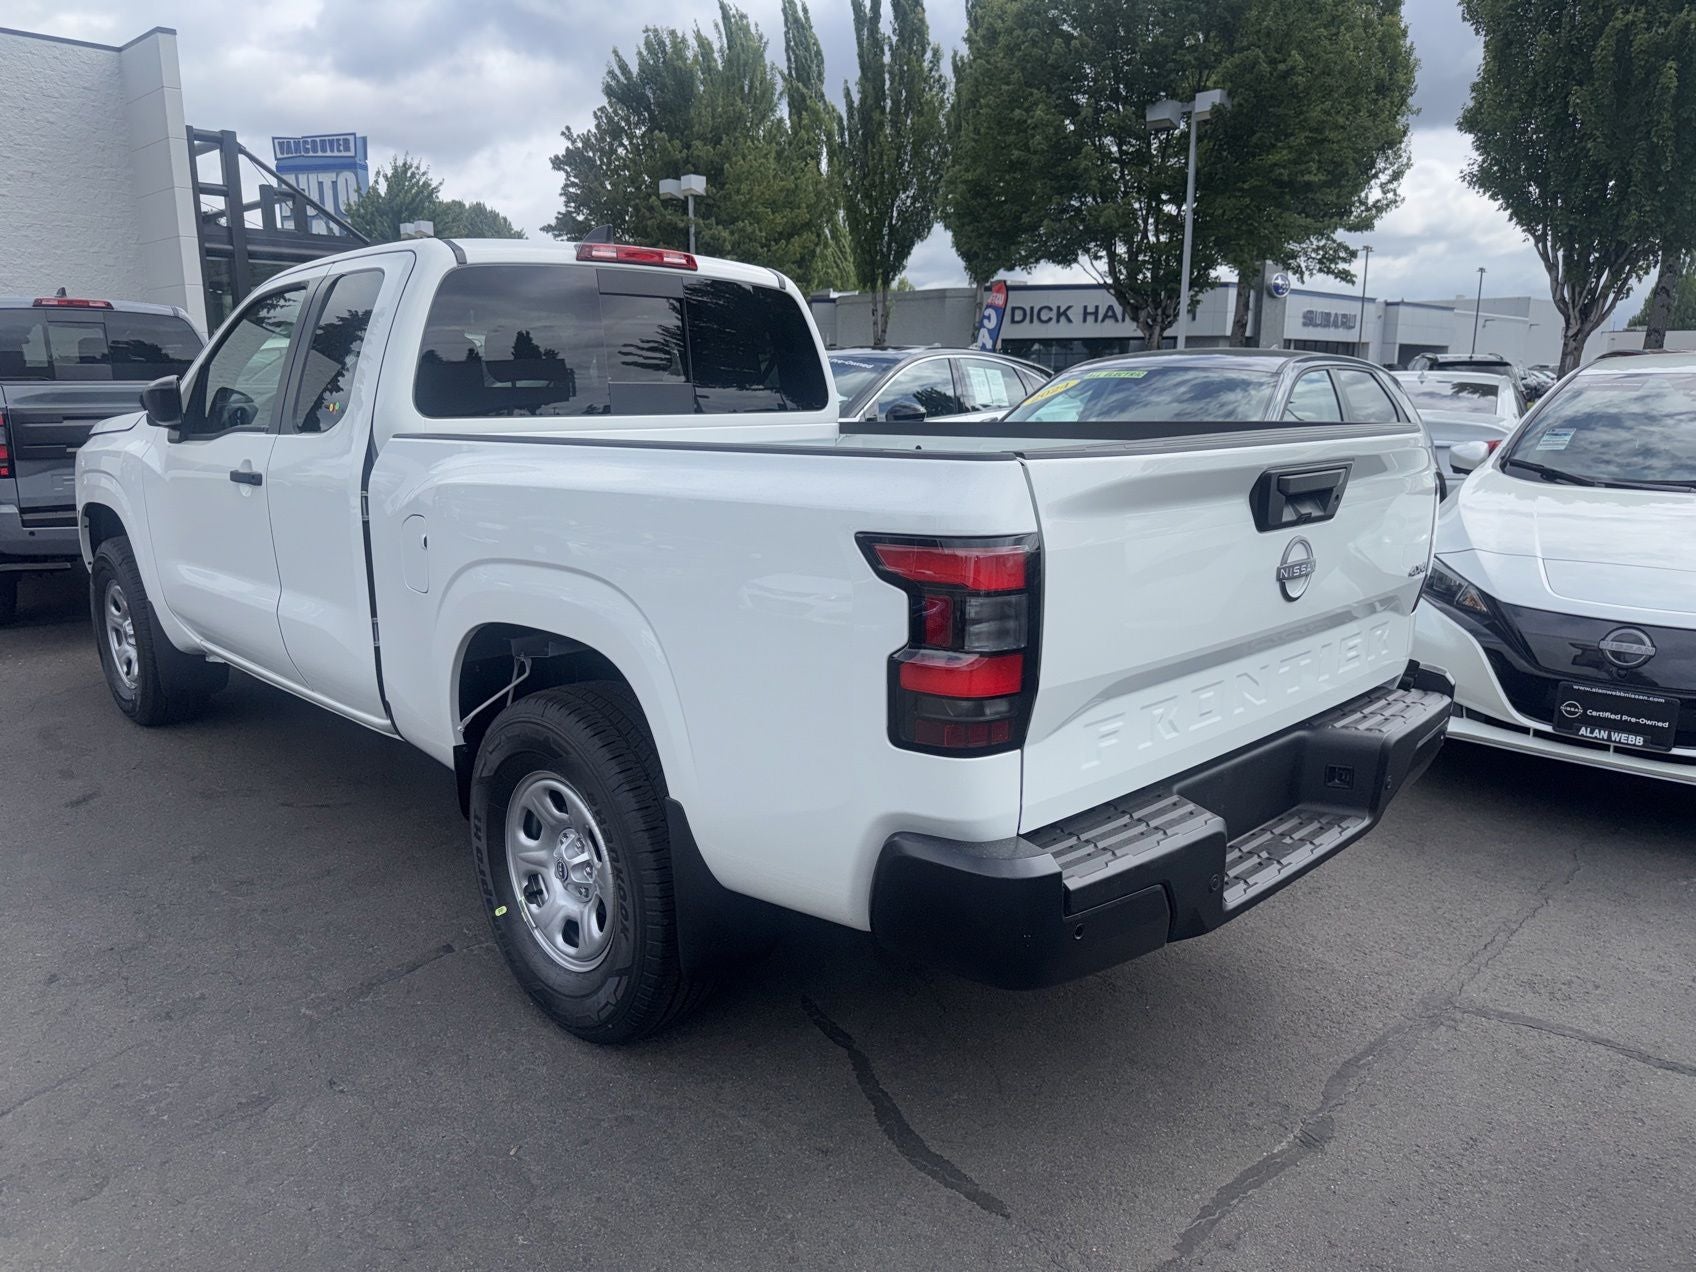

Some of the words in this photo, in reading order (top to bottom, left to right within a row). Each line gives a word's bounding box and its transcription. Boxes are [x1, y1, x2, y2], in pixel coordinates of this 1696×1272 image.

[277, 138, 351, 156] VANCOUVER
[1010, 305, 1074, 324] DICK
[1302, 310, 1357, 329] SUBARU
[1081, 620, 1390, 770] FRONTIER
[1573, 685, 1665, 703] www.alanwebbnissan.com
[1560, 705, 1583, 713] NISSAN
[1587, 709, 1620, 720] Certified
[1622, 715, 1669, 728] Pre-Owned
[1579, 727, 1608, 740] ALAN
[1611, 732, 1644, 746] WEBB
